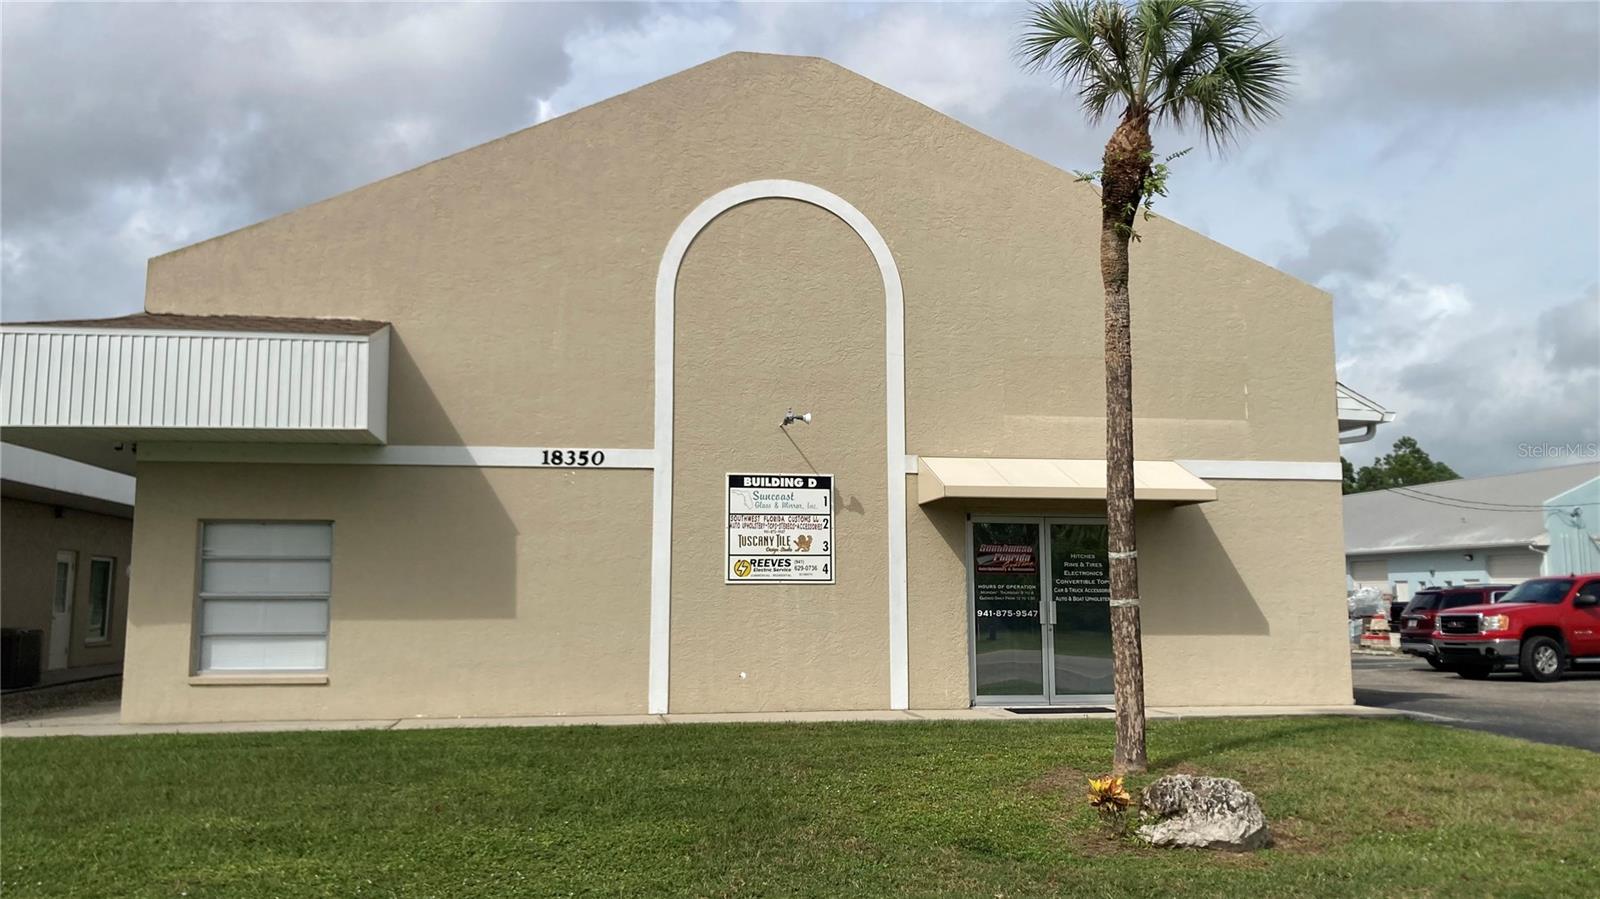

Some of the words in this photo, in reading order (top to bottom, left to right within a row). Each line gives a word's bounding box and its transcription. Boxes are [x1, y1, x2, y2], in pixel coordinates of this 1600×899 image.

[541, 450, 605, 466] 18350
[743, 477, 804, 487] BUILDING
[808, 478, 818, 487] D
[752, 490, 795, 501] Suncoast
[754, 501, 772, 509] Glass
[823, 496, 828, 507] 1
[787, 515, 811, 523] CUSTOMS
[823, 518, 829, 529] 2
[738, 534, 775, 548] TUSCANY
[776, 534, 791, 548] TILE
[822, 541, 829, 552] 3
[750, 558, 792, 567] REEVES
[822, 563, 829, 574] 4
